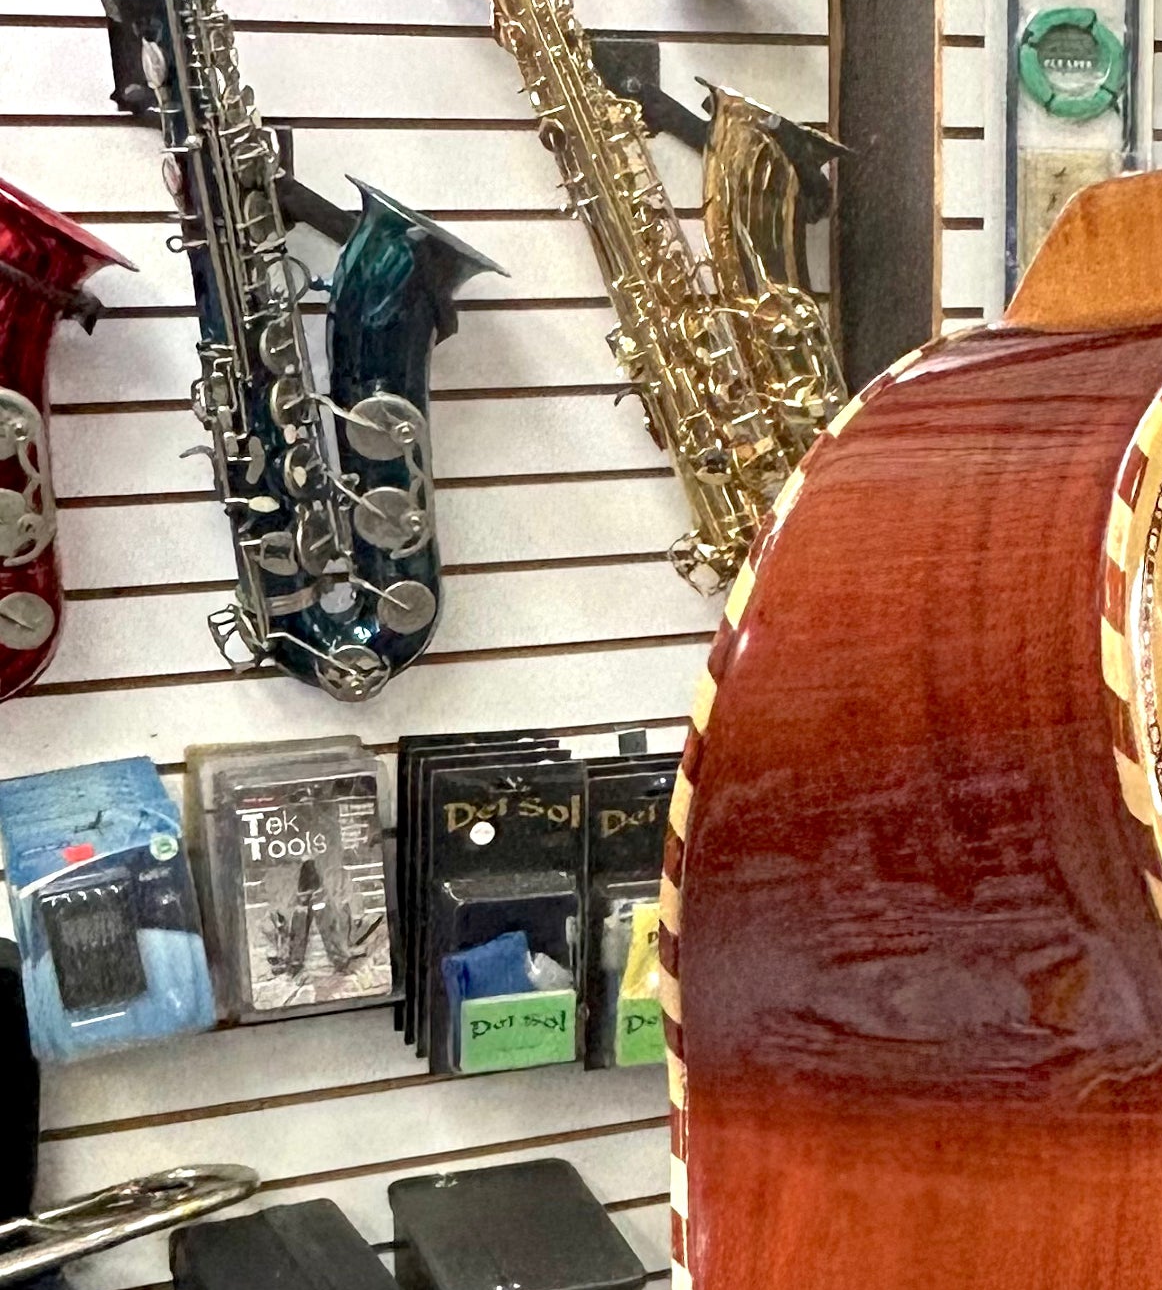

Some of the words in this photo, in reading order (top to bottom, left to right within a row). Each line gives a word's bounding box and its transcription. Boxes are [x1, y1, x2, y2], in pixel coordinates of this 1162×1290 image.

[241, 810, 300, 837] Tek
[444, 797, 508, 834] Del
[518, 793, 581, 829] Sol
[243, 831, 327, 861] Tools
[624, 1014, 658, 1035] De
